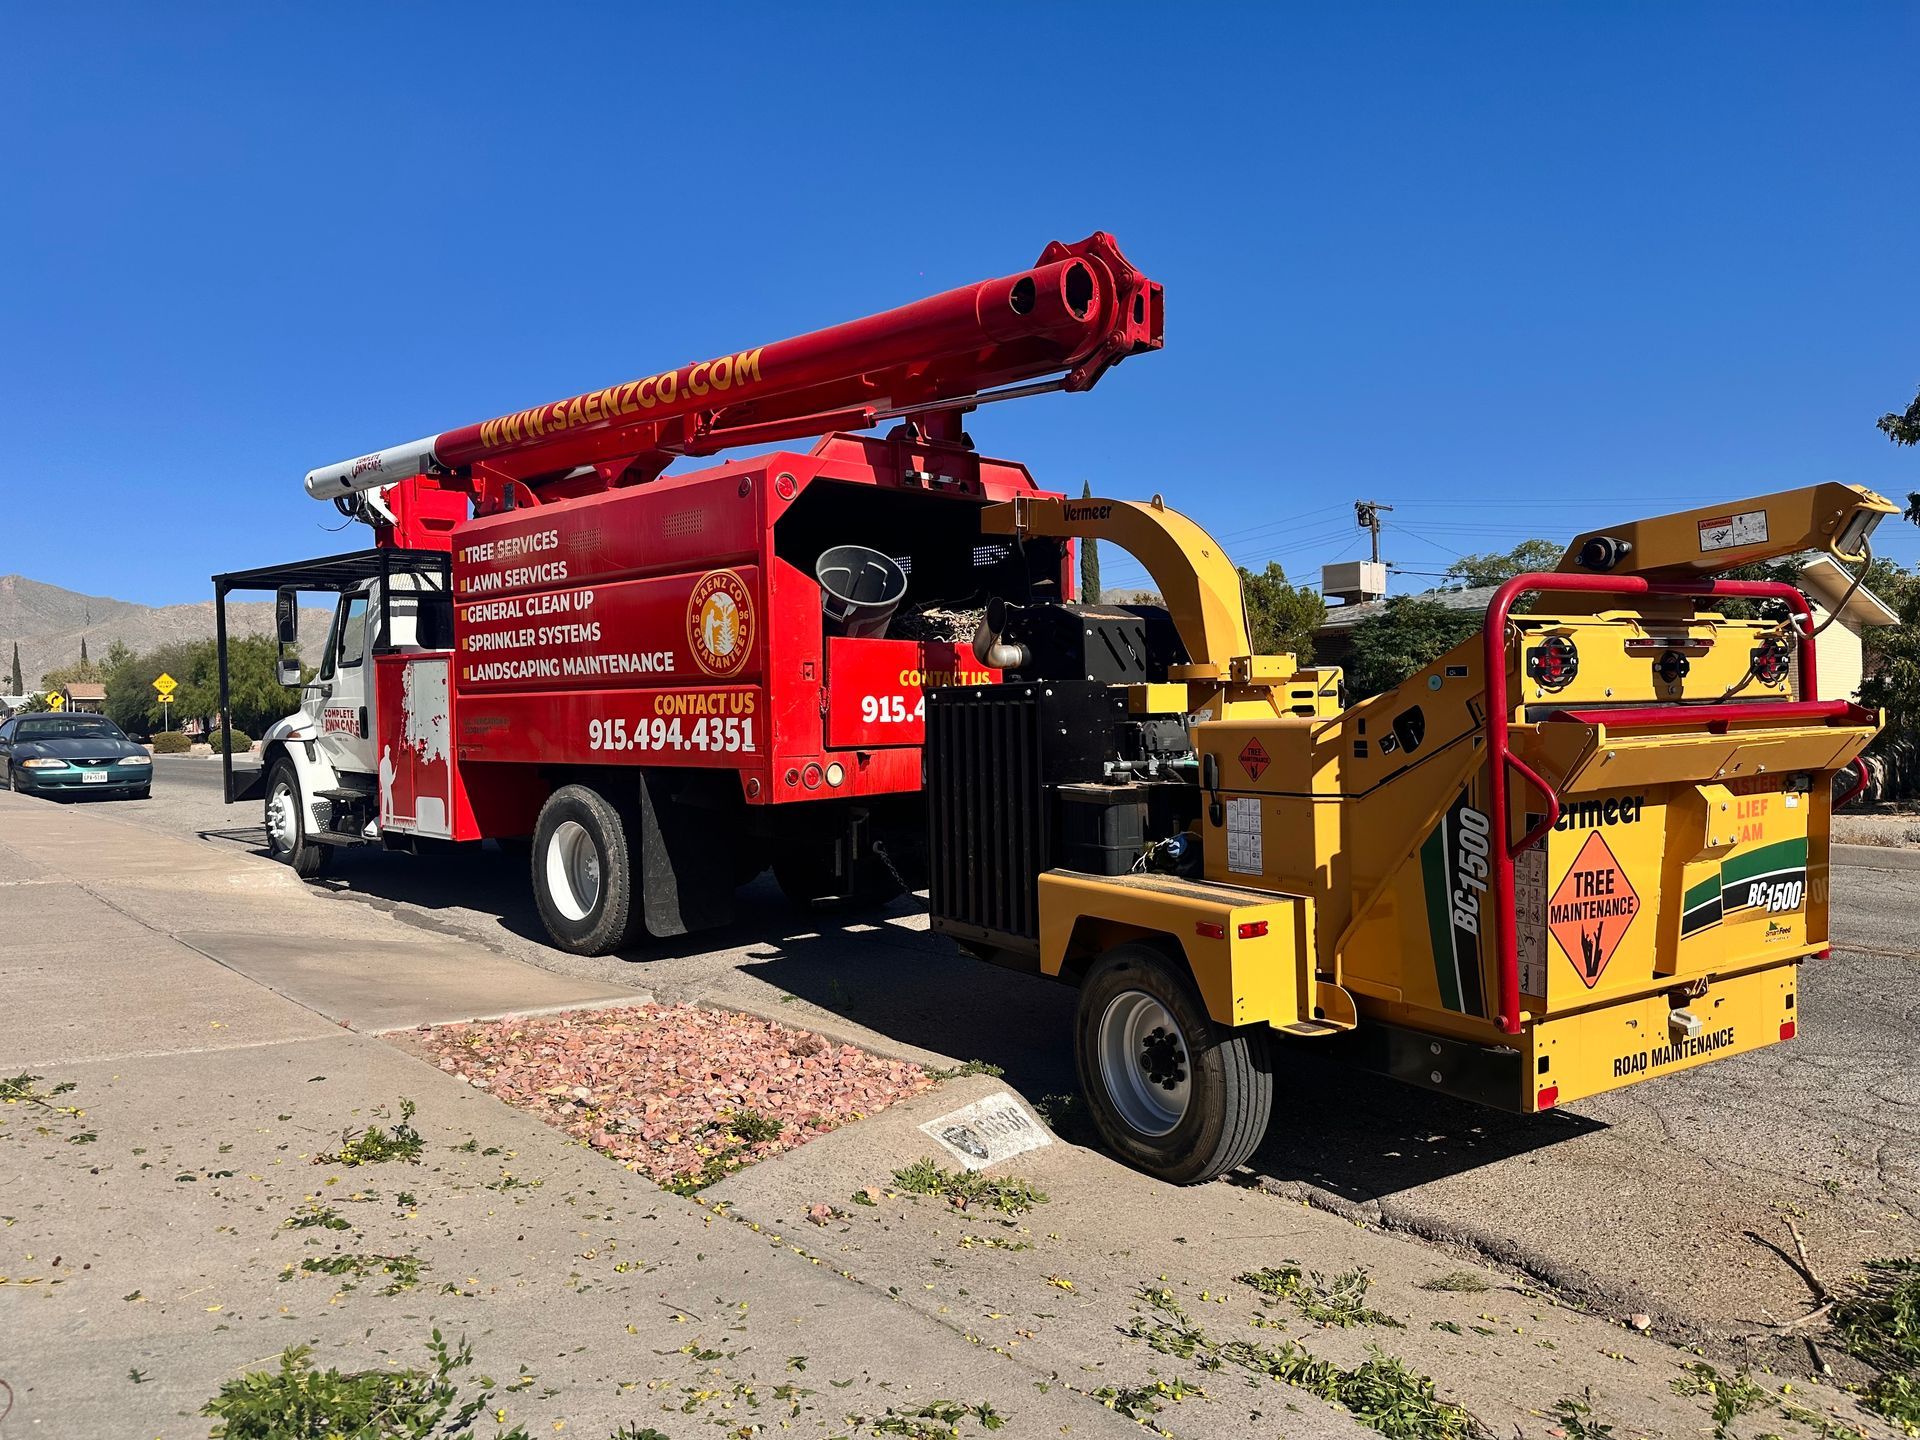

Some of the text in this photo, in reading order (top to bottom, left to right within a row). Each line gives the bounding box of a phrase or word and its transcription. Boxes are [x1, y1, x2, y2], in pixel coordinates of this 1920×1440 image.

[480, 348, 764, 448] WWW.SAENZCO.COM
[1064, 504, 1112, 521] Vermeer
[466, 530, 559, 563] TREE SERVICES
[466, 561, 568, 593] LAWN SERVICES
[695, 577, 743, 607] SAENZ CO.
[467, 590, 594, 623] GENERAL CLEAN UP
[692, 610, 749, 623] 19 96
[468, 622, 601, 652] SPRINKLER SYSTEMS
[694, 625, 747, 668] GUARANTEED
[469, 652, 675, 681] LANDSCAPING MAINTENANCE
[899, 669, 968, 687] CONTACT
[324, 709, 354, 719] COMPLETE
[654, 692, 755, 715] CONTACT US
[320, 719, 340, 732] AWN
[589, 717, 756, 752] 915.494.4351
[1247, 747, 1262, 756] TREE
[1553, 796, 1645, 832] ermeer
[1738, 822, 1763, 842] AM
[1453, 806, 1490, 936] BC1500
[1574, 868, 1615, 898] TREE
[1550, 896, 1634, 924] MAINTENANCE
[1748, 881, 1803, 912] BC1500
[1613, 1026, 1735, 1077] ROAD MAINTENANCE
